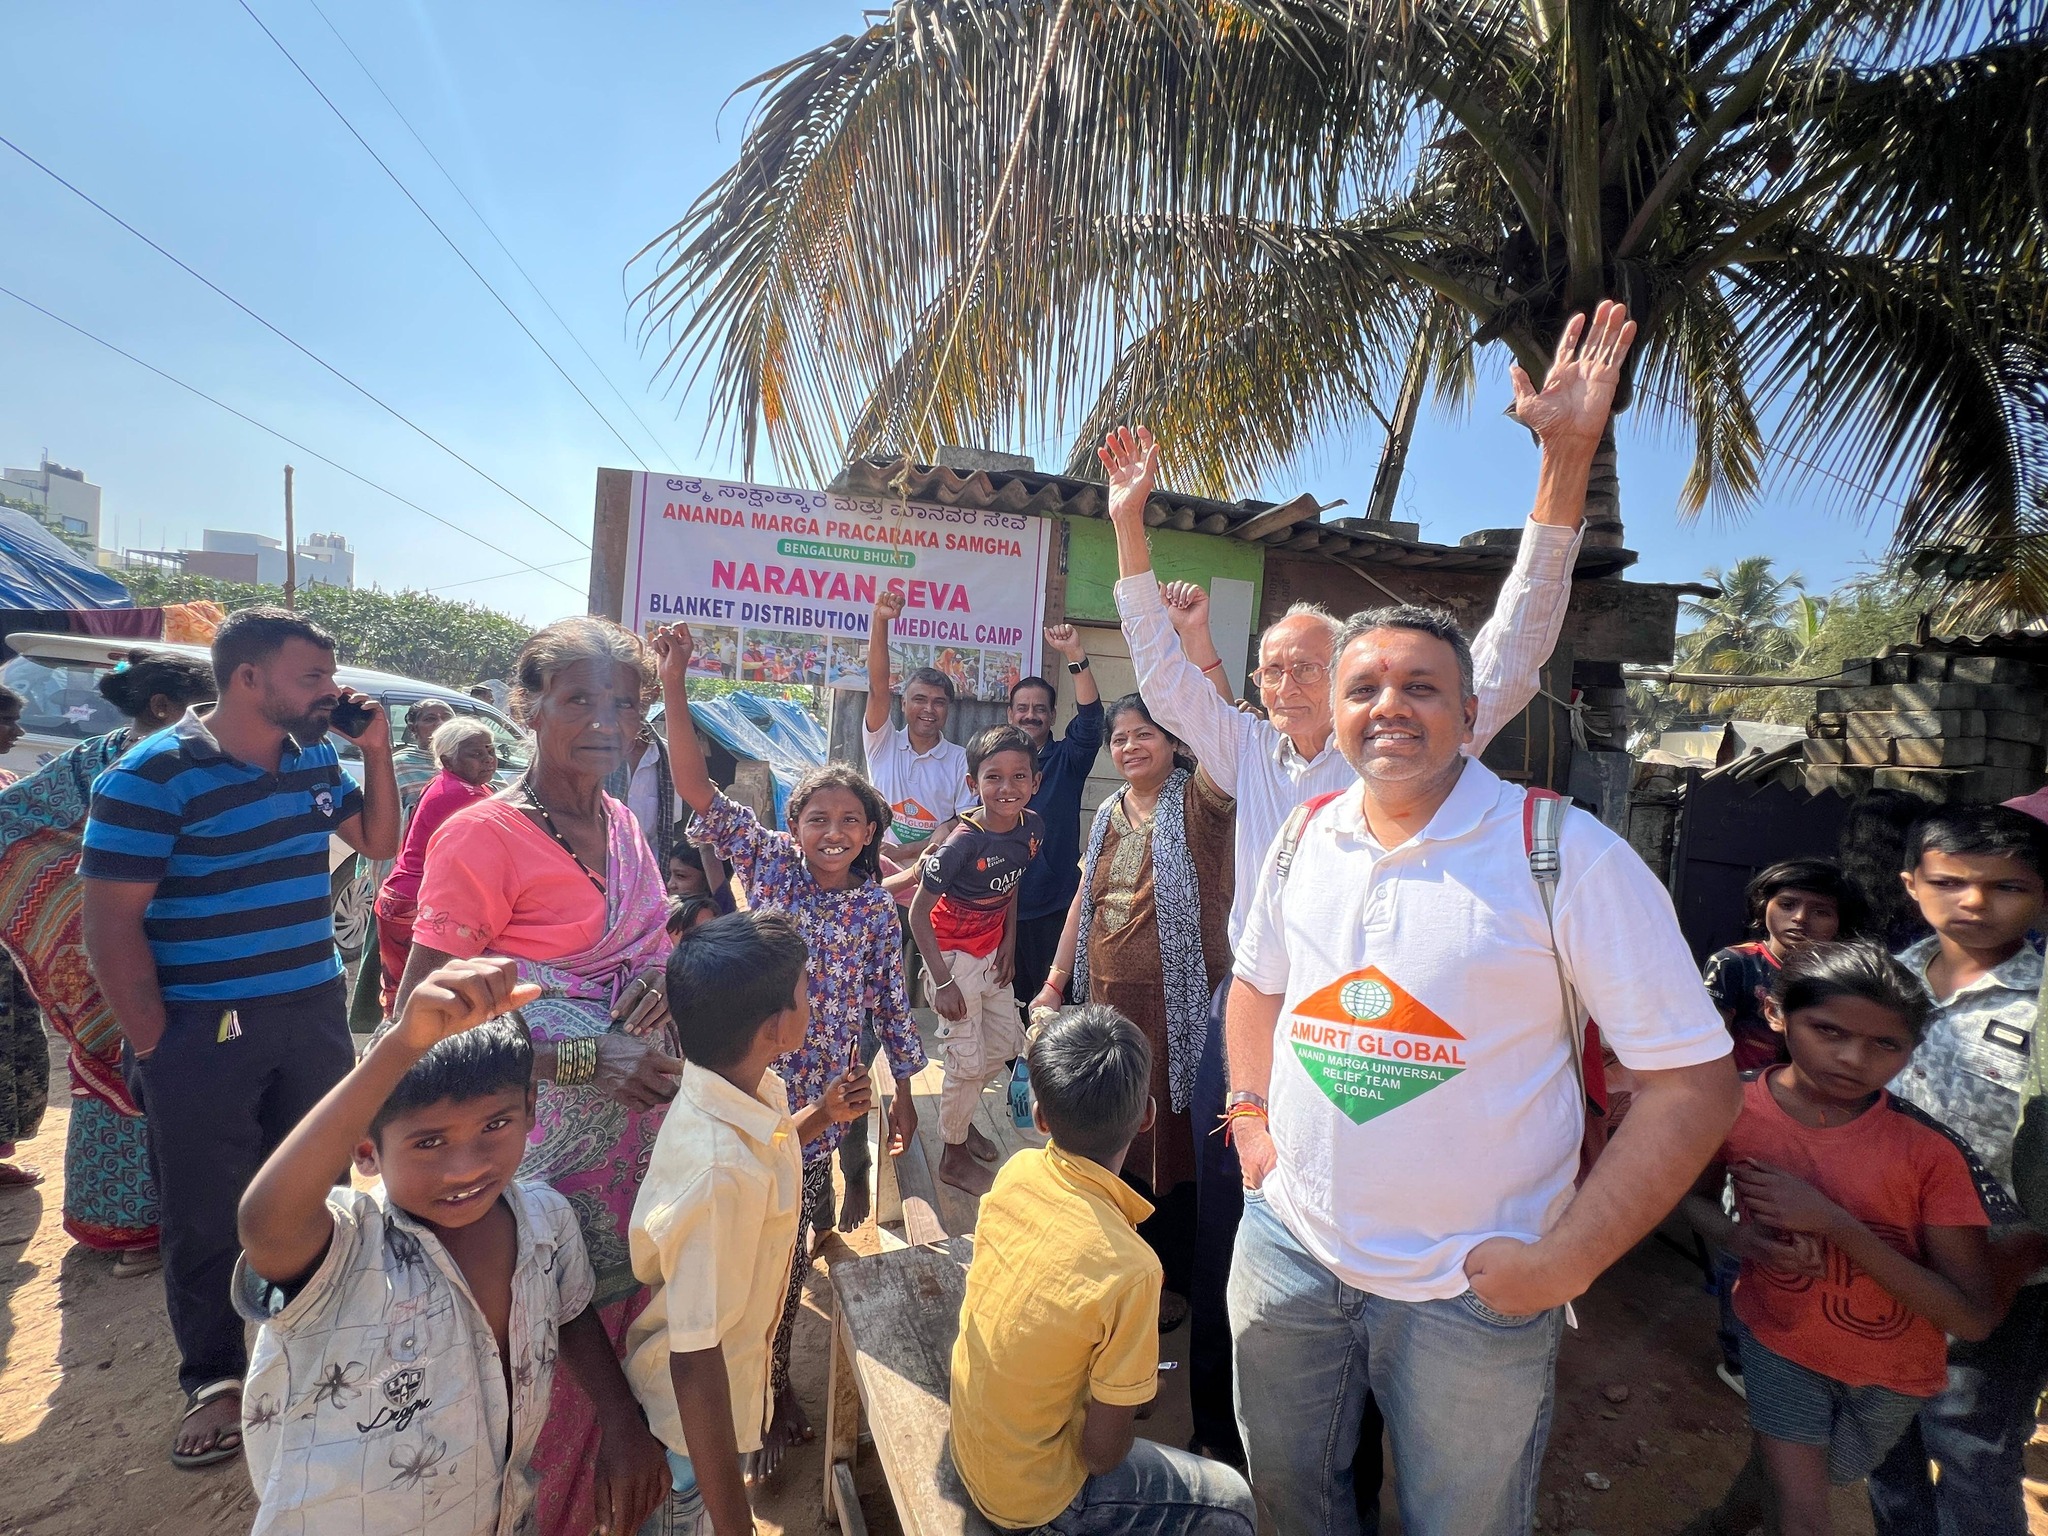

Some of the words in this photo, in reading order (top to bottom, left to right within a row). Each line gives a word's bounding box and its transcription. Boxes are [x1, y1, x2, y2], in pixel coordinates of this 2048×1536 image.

[666, 478, 714, 503] ಆತ್ಮ
[662, 502, 746, 528] ANANDA
[751, 512, 820, 537] MARGA
[825, 520, 940, 549] PRACARAKA
[945, 533, 1022, 558] SAMGHA
[784, 542, 859, 561] BENGALURU
[863, 551, 909, 566] BHUKTI
[711, 559, 877, 605] NARAYAN
[886, 577, 972, 613] SEVA
[649, 593, 736, 619] BLANKET
[741, 602, 870, 632] DISTRIBUTION
[893, 616, 970, 642] MEDICAL
[975, 624, 1023, 646] CAMP
[1290, 1020, 1351, 1049] AMURT
[1357, 1034, 1466, 1065] GLOBAL
[1297, 1047, 1326, 1063] ANAND
[1327, 1055, 1370, 1072] MARGA
[1372, 1063, 1445, 1081] UNIVERSAL
[1322, 1067, 1362, 1082] RELIEF
[1365, 1075, 1401, 1090] TEAM
[1334, 1083, 1385, 1101] GLOBAL
